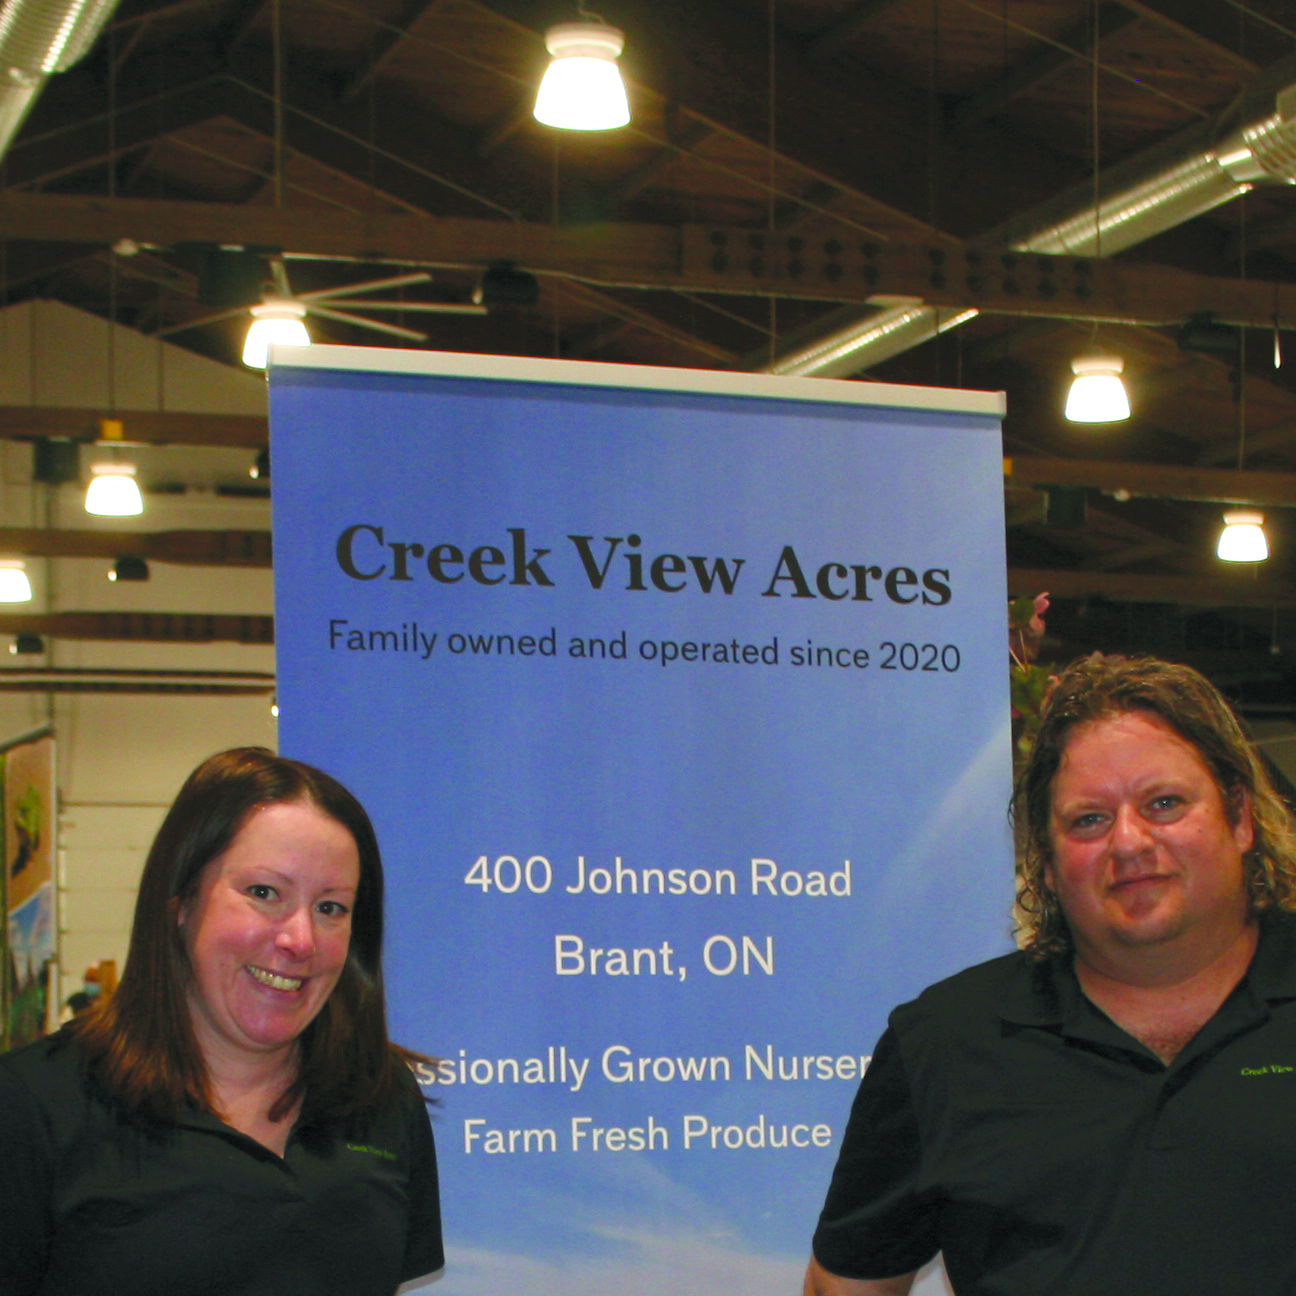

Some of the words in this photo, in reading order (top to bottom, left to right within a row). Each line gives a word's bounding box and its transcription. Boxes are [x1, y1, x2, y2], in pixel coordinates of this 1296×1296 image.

[335, 523, 554, 587] Creek
[567, 534, 745, 596] View
[762, 544, 953, 607] Acres
[328, 619, 437, 660] Family
[447, 627, 557, 657] owned
[568, 631, 628, 659] and
[639, 637, 780, 667] operated
[790, 639, 870, 669] since
[879, 642, 961, 673] 2020
[464, 855, 553, 895] 400
[566, 856, 738, 896] Johnson
[750, 857, 853, 897] Road
[554, 933, 688, 982] Brant,
[702, 933, 775, 976] ON
[407, 1046, 590, 1092] ssionally
[601, 1044, 731, 1084] Grown
[745, 1044, 872, 1080] Nurser
[464, 1118, 557, 1154] Farm
[570, 1116, 669, 1152] Fresh
[682, 1114, 832, 1151] Produce
